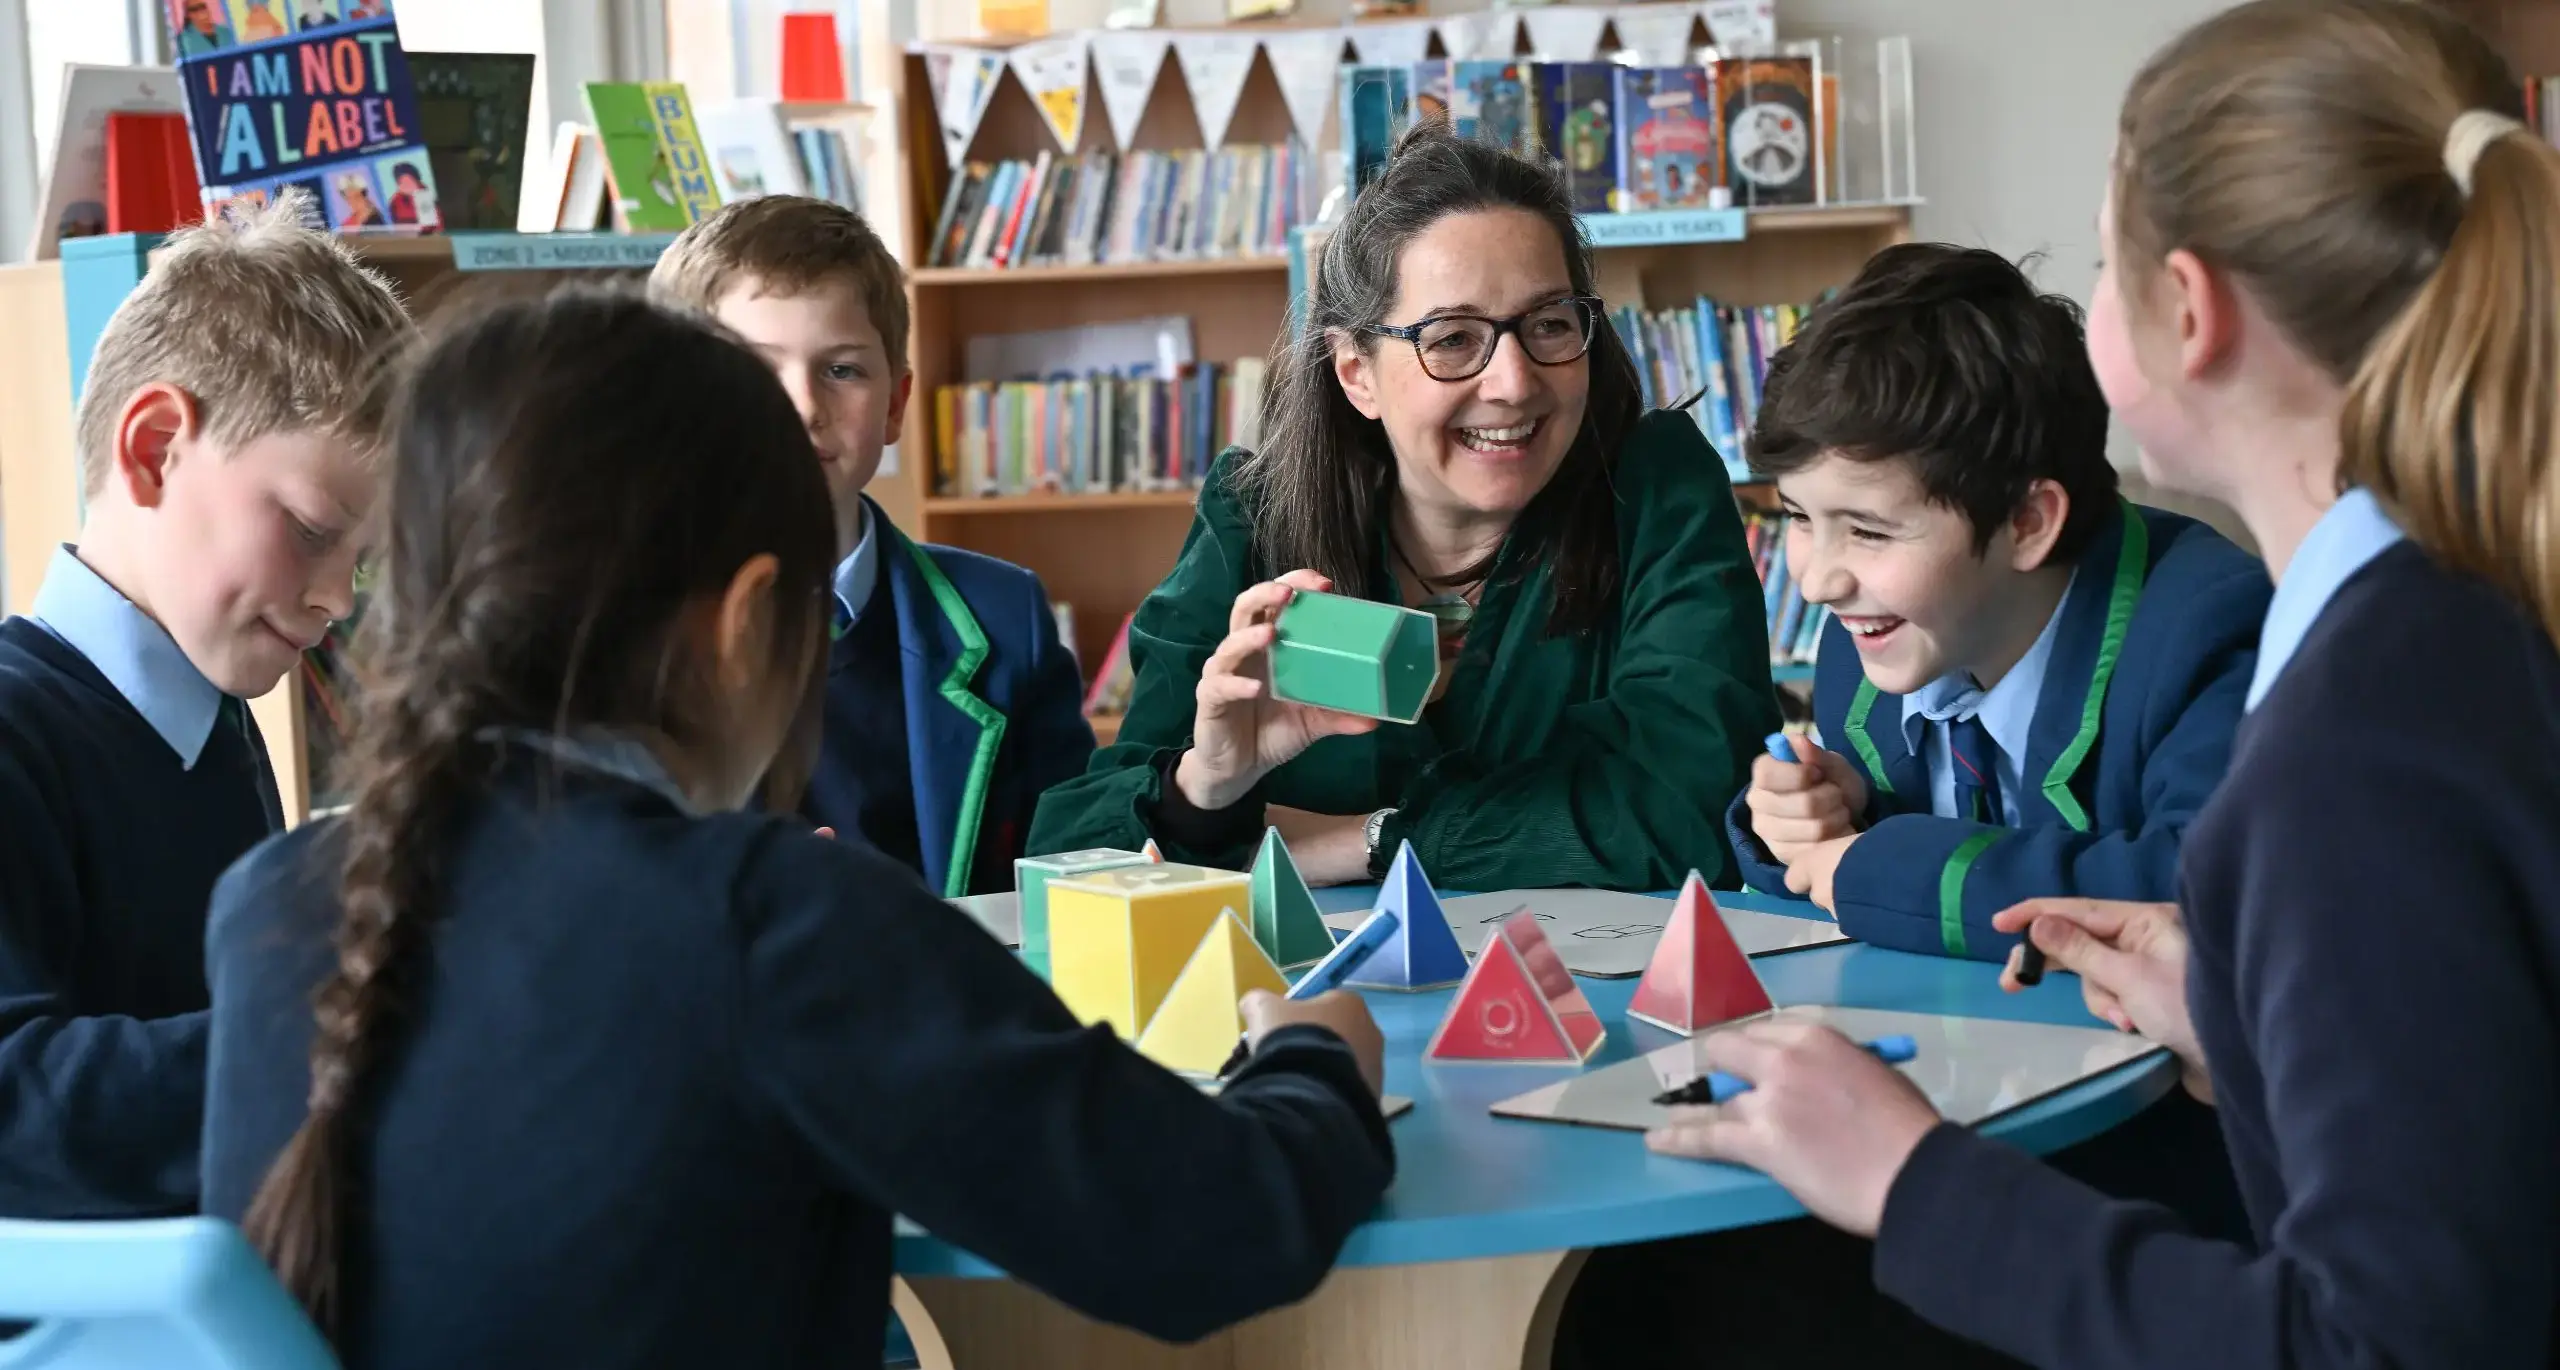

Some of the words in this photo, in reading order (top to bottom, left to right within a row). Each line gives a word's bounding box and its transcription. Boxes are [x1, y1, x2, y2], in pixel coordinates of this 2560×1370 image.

[206, 65, 219, 97] I
[229, 53, 292, 97] AM
[299, 33, 395, 96] NOT
[219, 102, 267, 176] A
[271, 98, 405, 164] LABEL
[1670, 218, 1725, 235] YEARS
